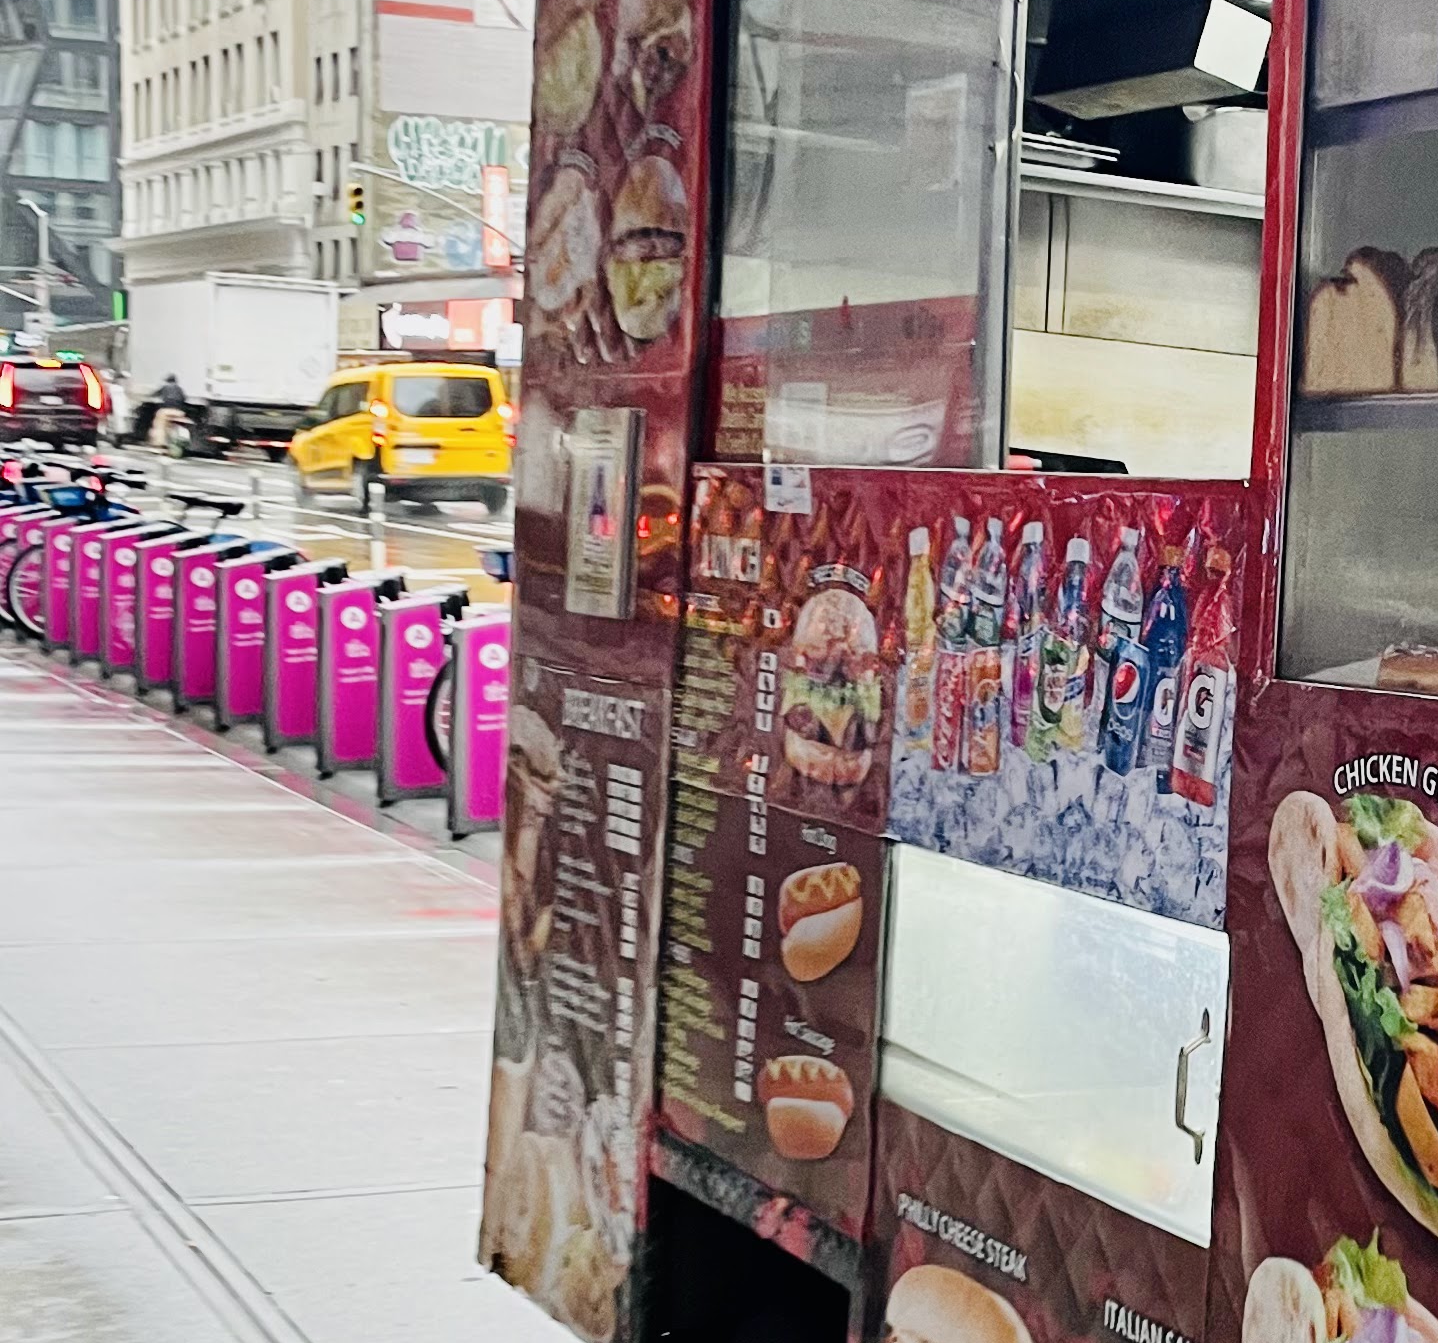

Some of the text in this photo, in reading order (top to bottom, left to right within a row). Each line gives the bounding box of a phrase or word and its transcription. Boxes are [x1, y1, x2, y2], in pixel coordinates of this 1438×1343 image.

[1188, 674, 1216, 730] G
[1333, 754, 1420, 796] CHICKEN
[938, 1215, 985, 1259] CHEESE
[985, 1238, 1028, 1282] STEAK
